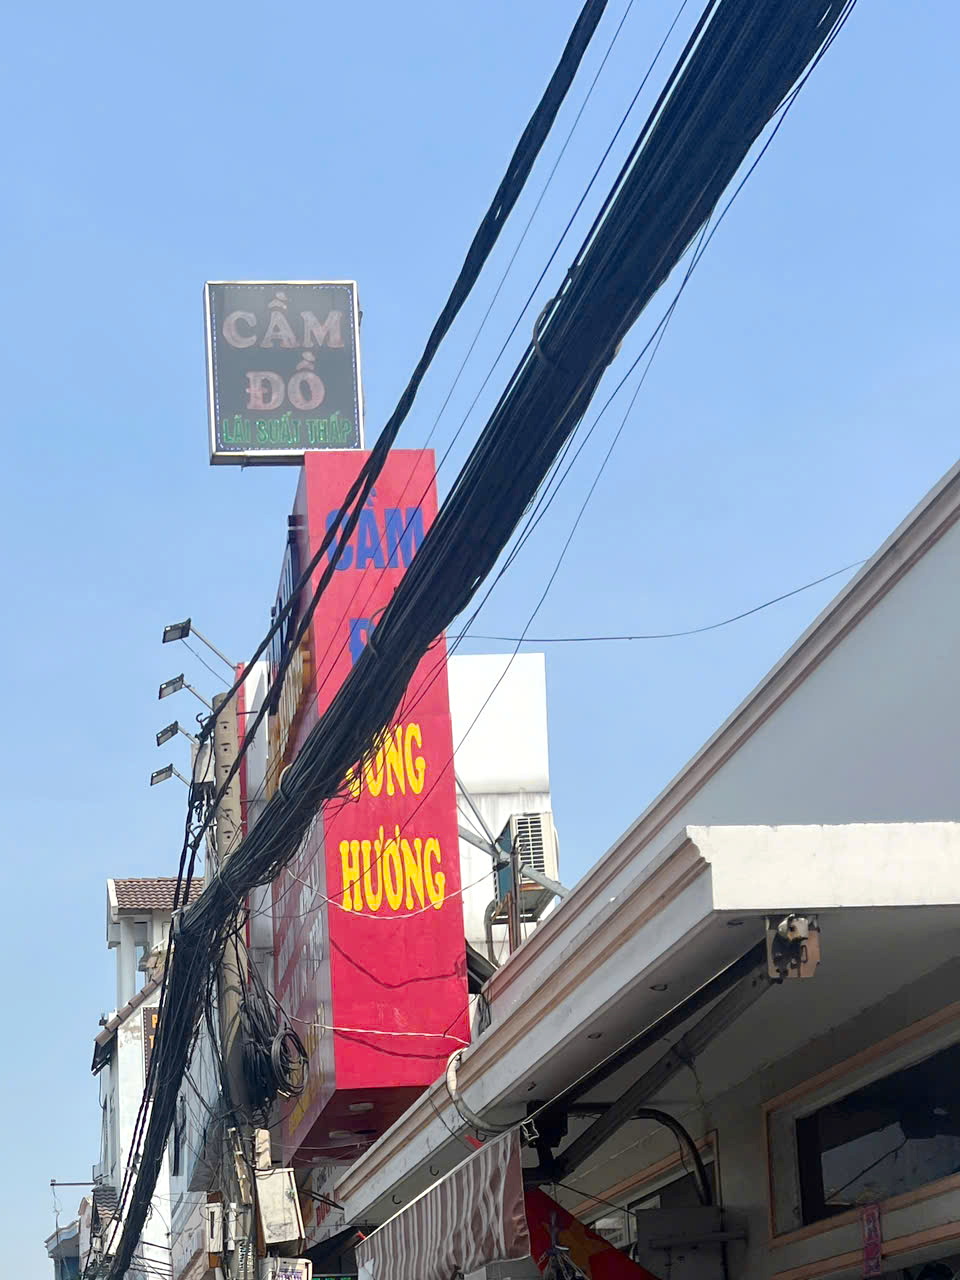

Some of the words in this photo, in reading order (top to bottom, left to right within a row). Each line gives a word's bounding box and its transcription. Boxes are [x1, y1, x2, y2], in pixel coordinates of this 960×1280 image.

[222, 291, 345, 348] CẦM
[245, 351, 326, 410] ĐỒ
[223, 413, 252, 443] LÃI
[255, 411, 300, 443] SUẤT
[306, 410, 352, 443] THẤP
